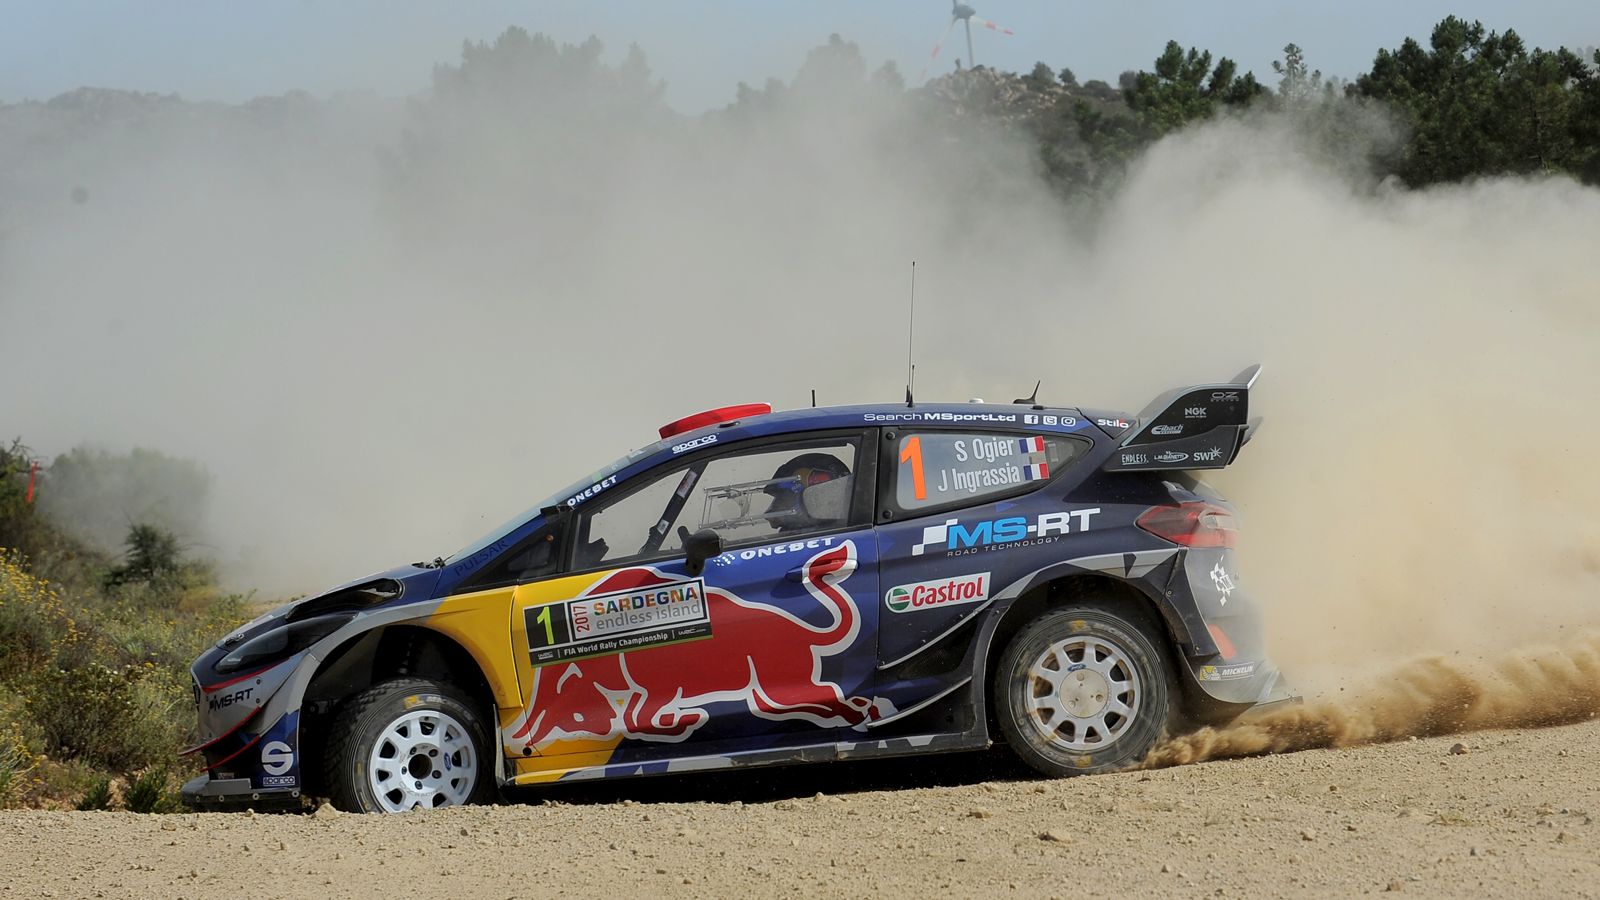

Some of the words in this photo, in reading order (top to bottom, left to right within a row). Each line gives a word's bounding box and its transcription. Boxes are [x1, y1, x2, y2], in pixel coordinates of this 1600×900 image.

[864, 413, 923, 422] Search
[924, 412, 1016, 422] MSportLtd
[1097, 418, 1130, 429] Stilo
[1184, 407, 1207, 415] NGK
[1151, 424, 1184, 435] Eibach
[671, 434, 718, 454] sparco
[954, 441, 969, 462] S
[974, 437, 1014, 463] Ogier
[1193, 450, 1219, 462] SWP
[900, 436, 927, 500] 1
[937, 470, 948, 492] J
[954, 462, 1021, 494] Ingrassia
[566, 474, 617, 508] ONEBET
[947, 508, 1101, 549] MS-RT
[740, 536, 836, 560] ONEBET
[947, 547, 978, 557] ROAD
[984, 535, 1060, 553] TECHNOLOGY
[593, 587, 698, 615] SARDEGNA
[912, 577, 983, 607] Castrol
[536, 605, 555, 645] 1
[573, 604, 591, 632] 2017
[596, 609, 654, 631] endless
[656, 599, 702, 619] island
[563, 647, 577, 656] FIA
[577, 643, 599, 655] World
[599, 640, 618, 652] Rally
[618, 631, 669, 649] Championship
[213, 687, 254, 712] MS-RT
